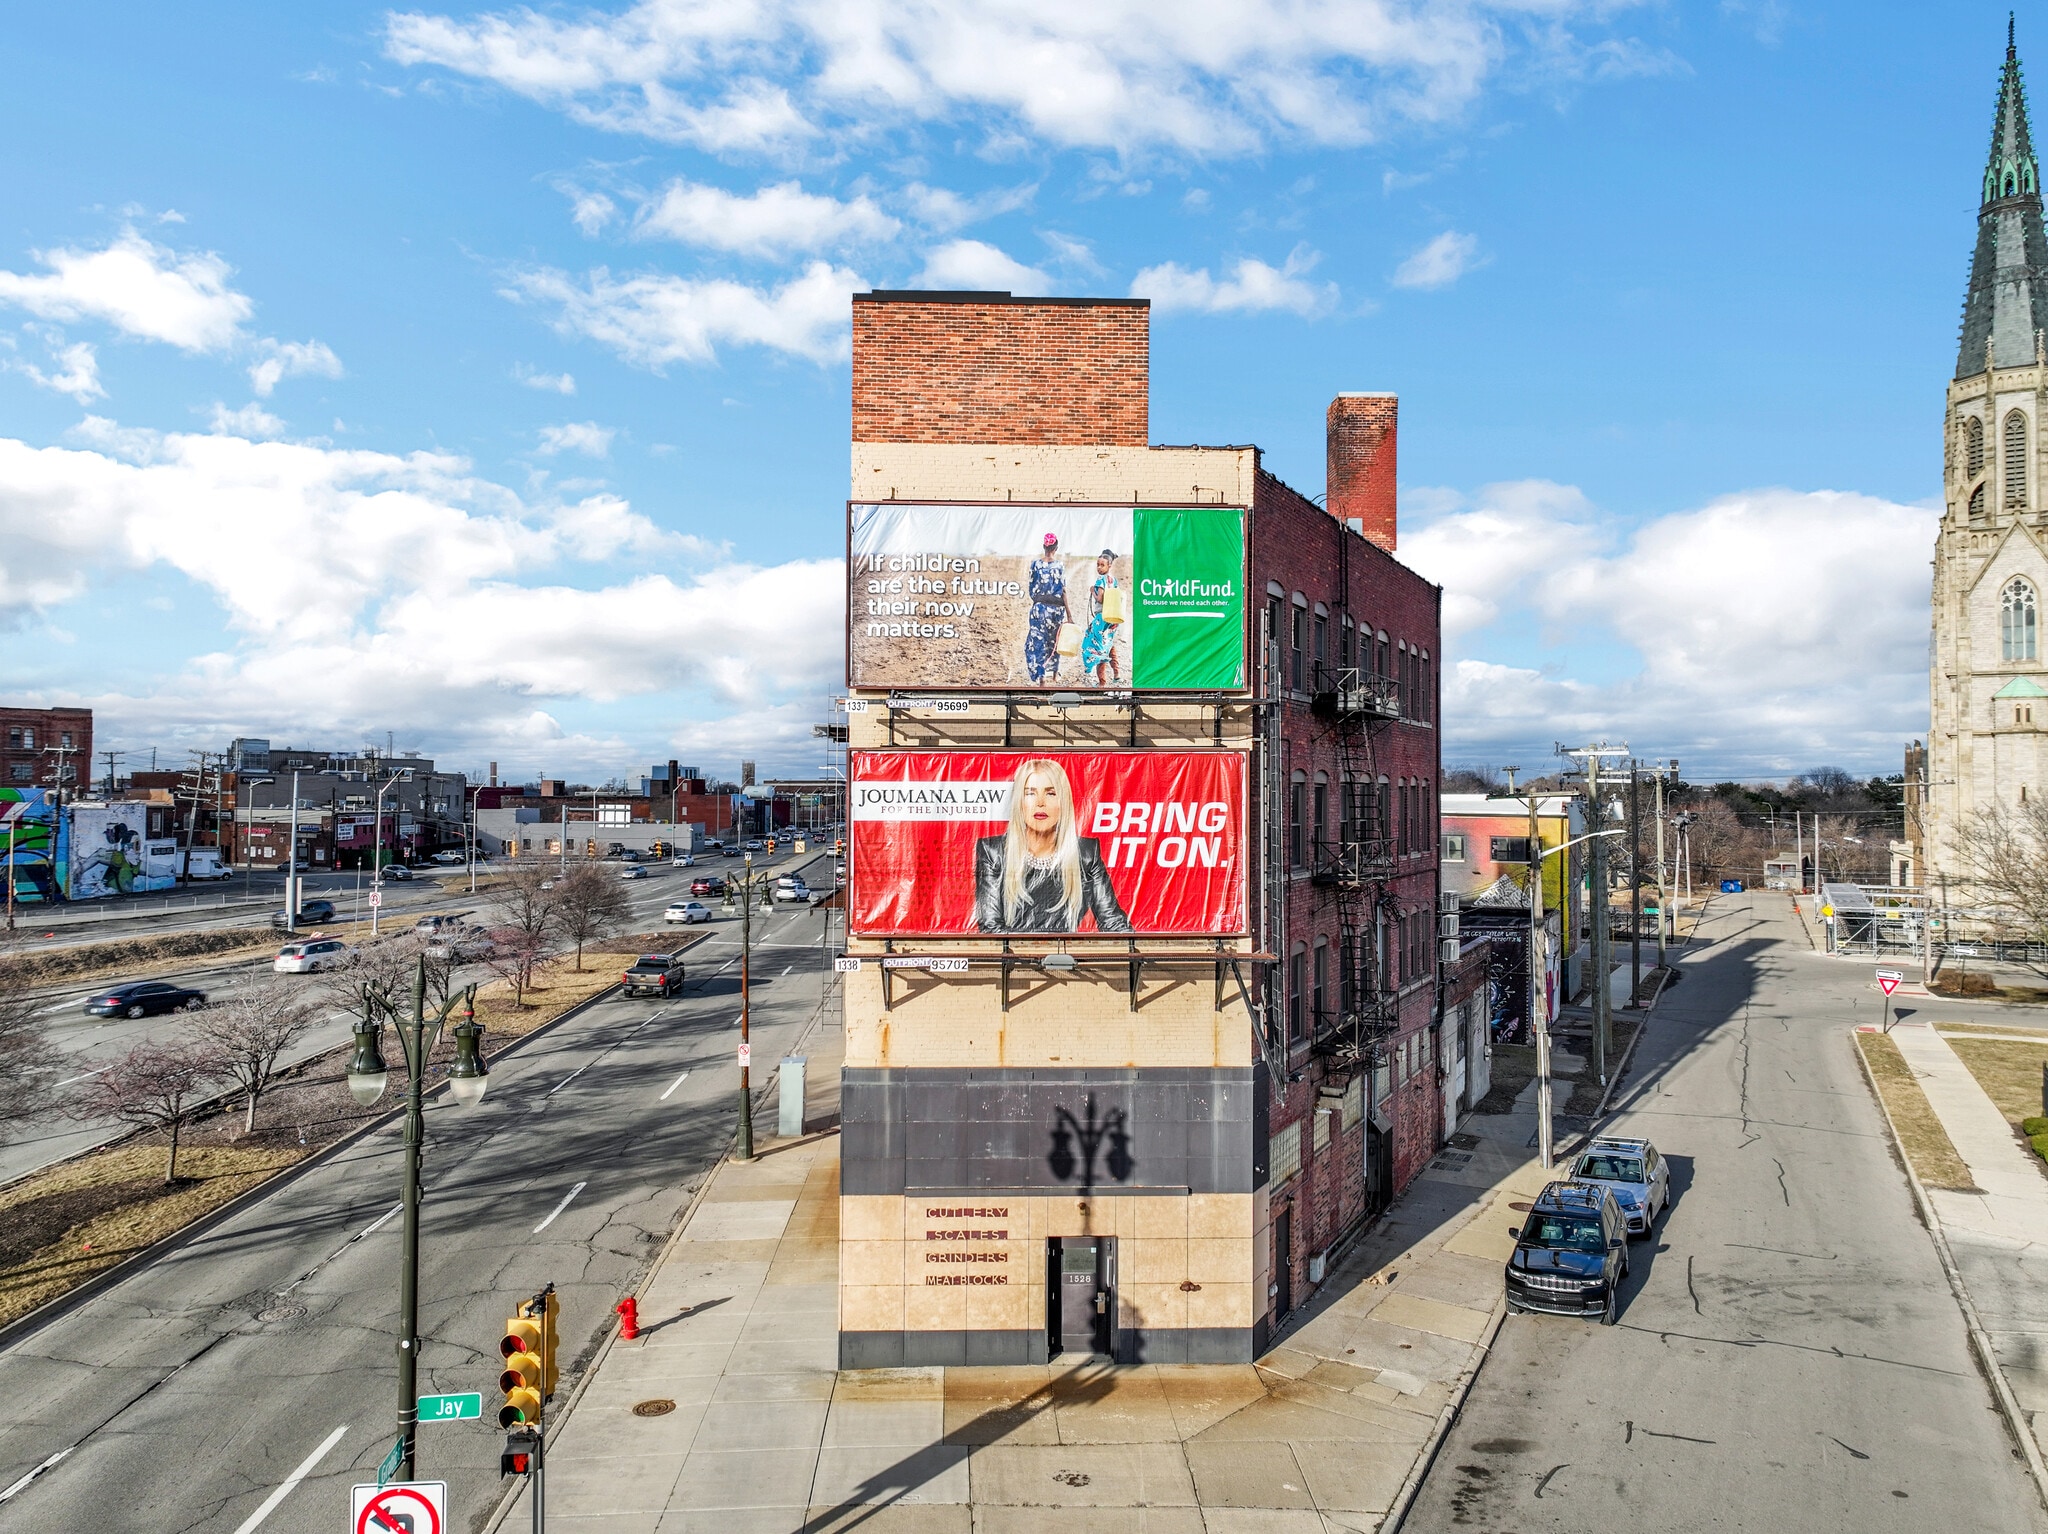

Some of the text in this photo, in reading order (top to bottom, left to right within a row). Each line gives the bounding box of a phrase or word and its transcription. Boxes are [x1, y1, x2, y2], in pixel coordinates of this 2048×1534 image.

[868, 552, 980, 572] If children
[867, 575, 1025, 598] are the future,
[867, 597, 974, 616] their now
[867, 621, 960, 638] matters.
[847, 702, 867, 711] 1337
[937, 702, 968, 711] 95699
[858, 789, 1006, 807] JOUMANA LAW
[908, 806, 932, 814] THE
[936, 806, 987, 815] INJURED
[1092, 802, 1228, 833] BRING
[1107, 836, 1228, 868] IT ON.
[837, 960, 858, 970] 1338
[931, 960, 968, 969] 95702
[926, 1208, 1008, 1218] CUTLERY
[926, 1253, 1008, 1263] GRINDERS
[961, 1275, 1007, 1286] BLOCKS
[1069, 1275, 1091, 1283] 1528
[435, 1398, 464, 1417] Jay
